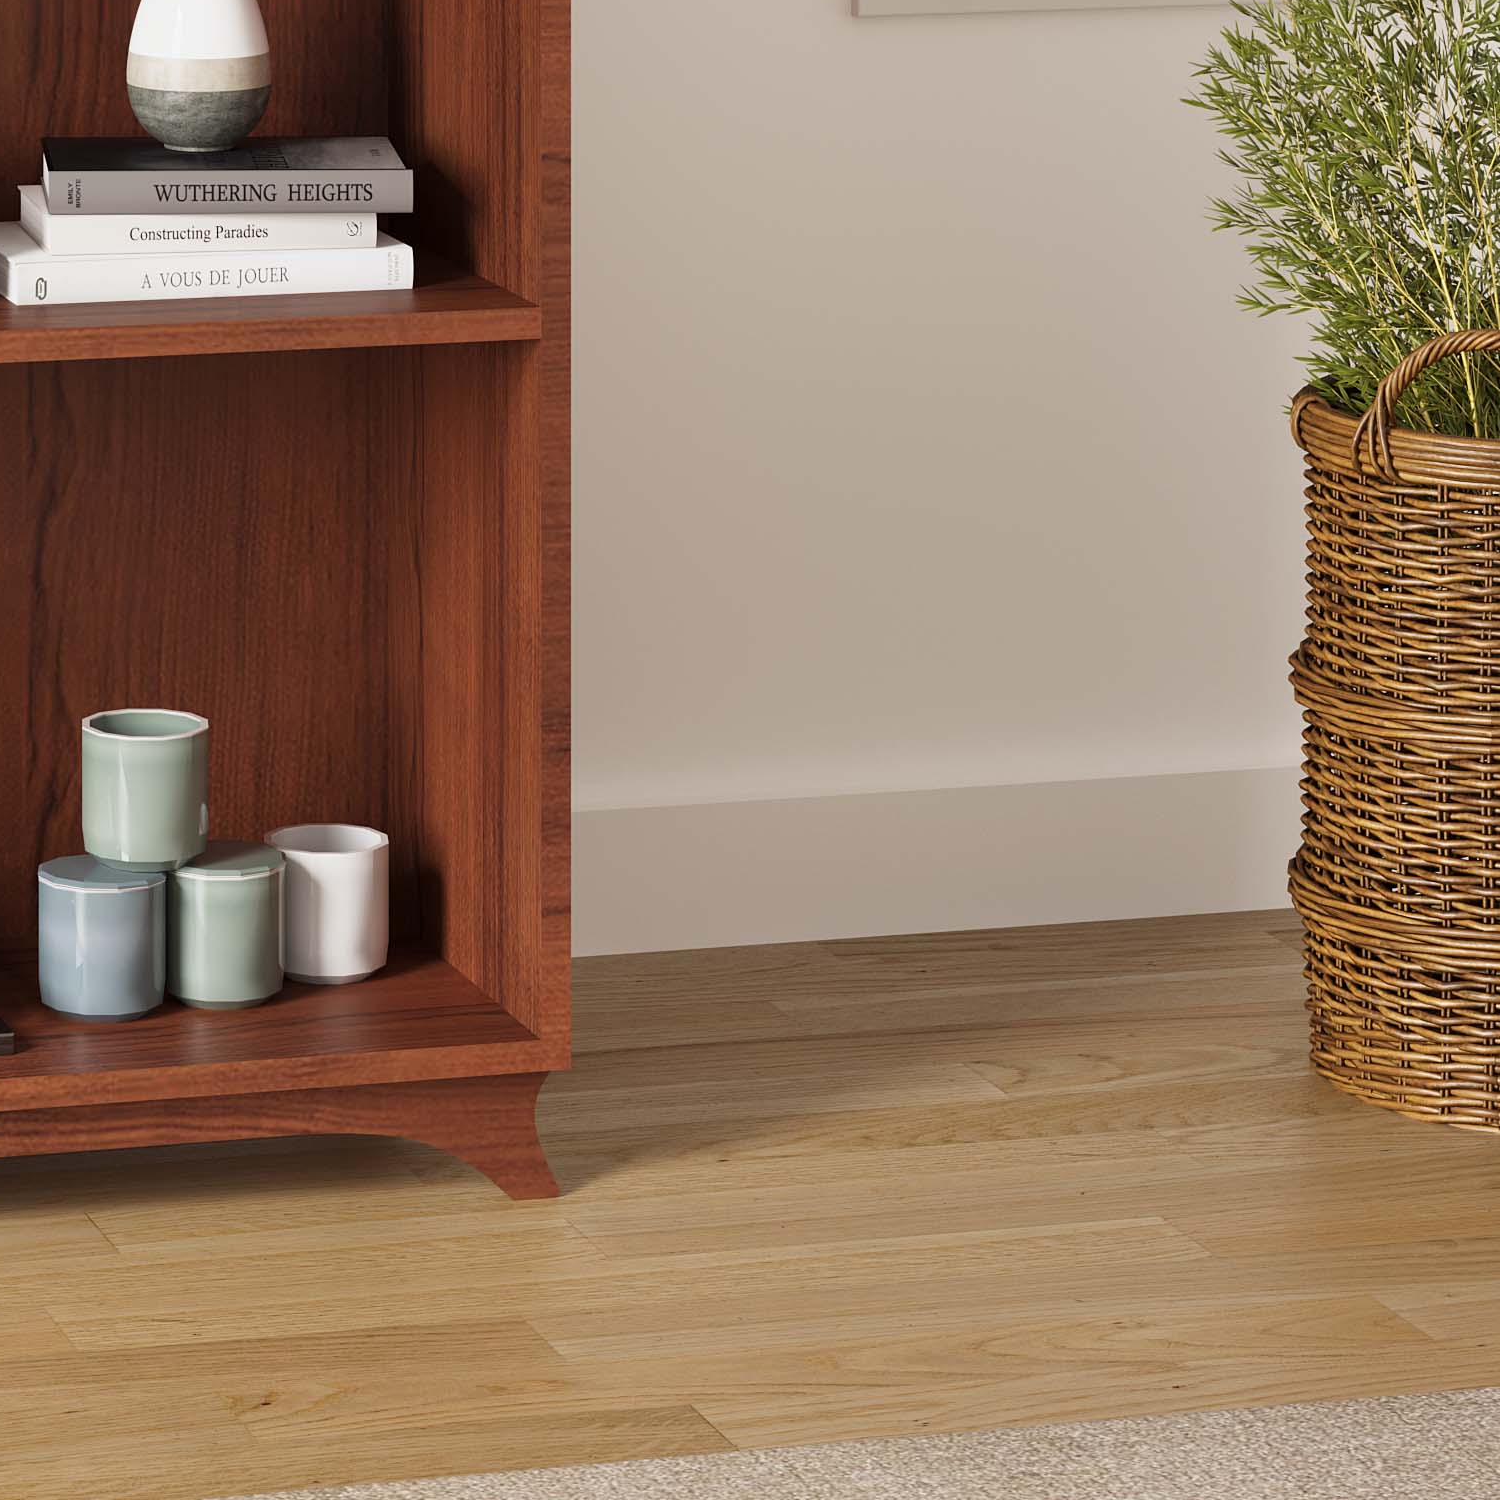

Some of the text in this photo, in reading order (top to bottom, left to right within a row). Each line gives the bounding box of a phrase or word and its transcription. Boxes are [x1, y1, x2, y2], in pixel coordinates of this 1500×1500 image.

[154, 182, 373, 203] WUTHERING HEIGHTS
[129, 224, 268, 243] Constructing Paradies
[141, 267, 289, 289] A VOUS DE JOUER
